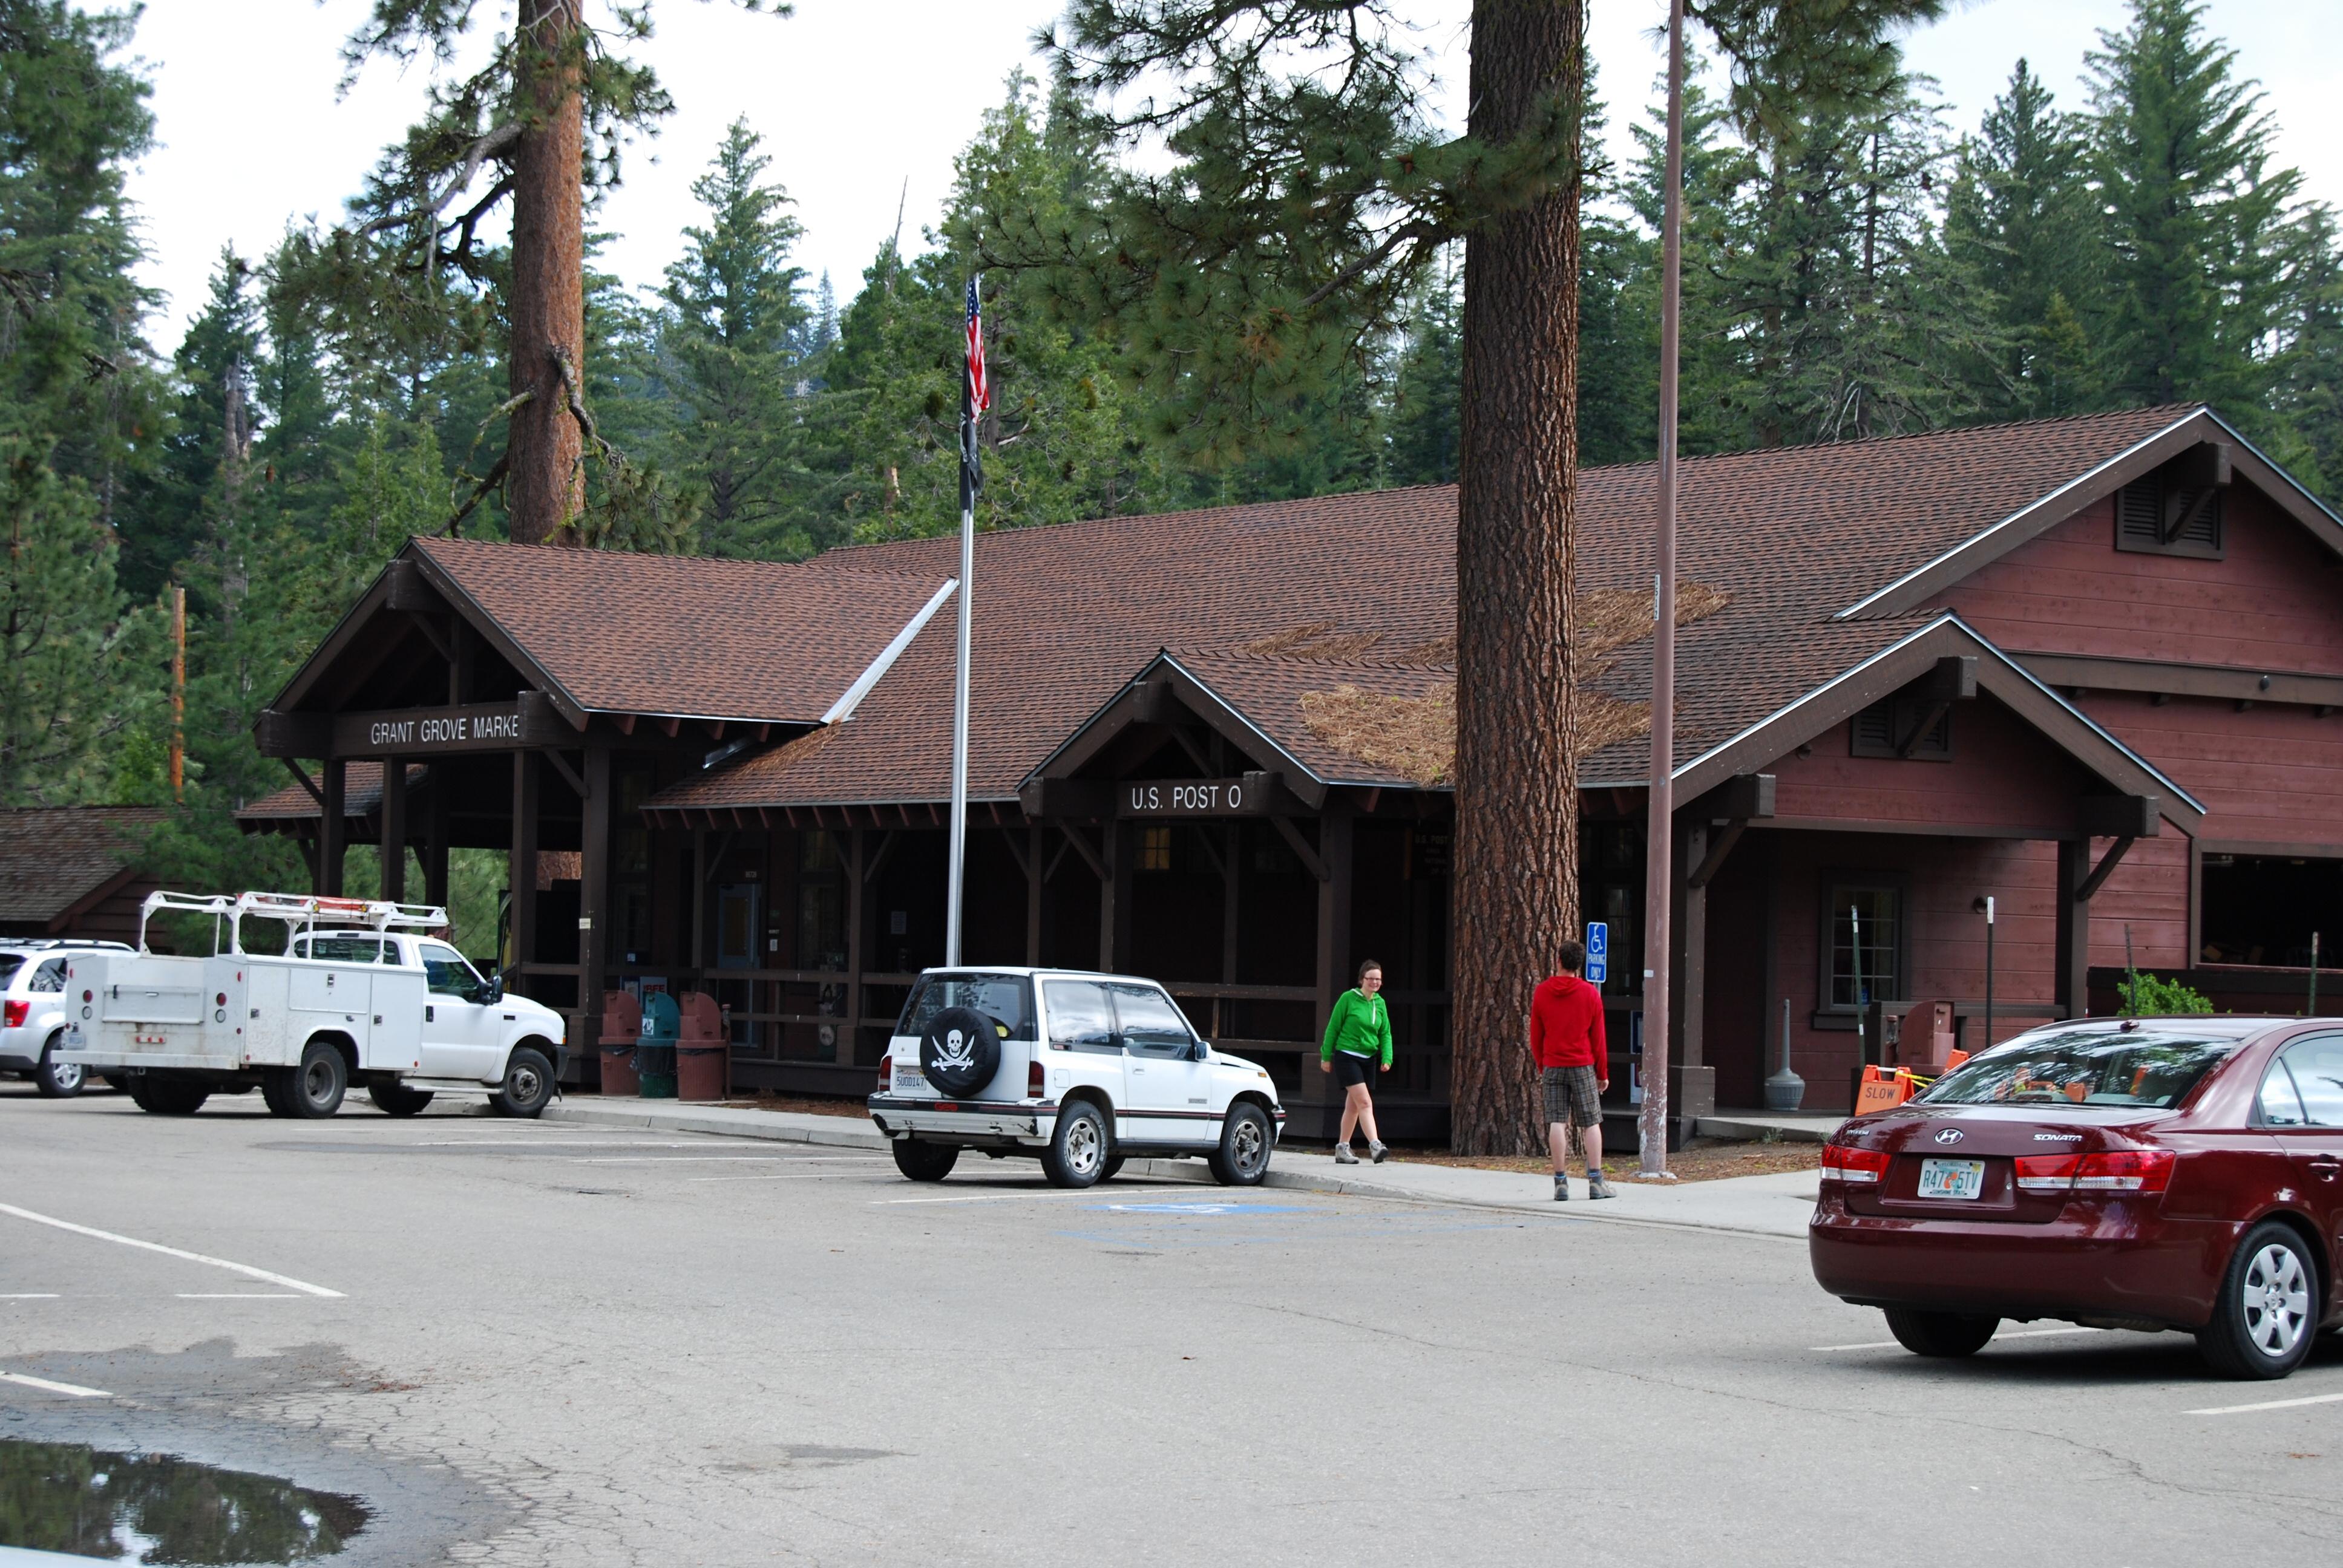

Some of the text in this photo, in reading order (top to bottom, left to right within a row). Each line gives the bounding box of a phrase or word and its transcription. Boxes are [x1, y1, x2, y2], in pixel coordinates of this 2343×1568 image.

[372, 721, 415, 744] GRANT
[421, 718, 467, 742] GROVE
[1132, 786, 1163, 809] U.S.
[1173, 786, 1219, 809] POST
[1588, 953, 1605, 965] PARKING
[1590, 966, 1602, 978] ONLY
[1866, 1087, 1895, 1099] SLOW
[1923, 1170, 1978, 1189] R47 5TV
